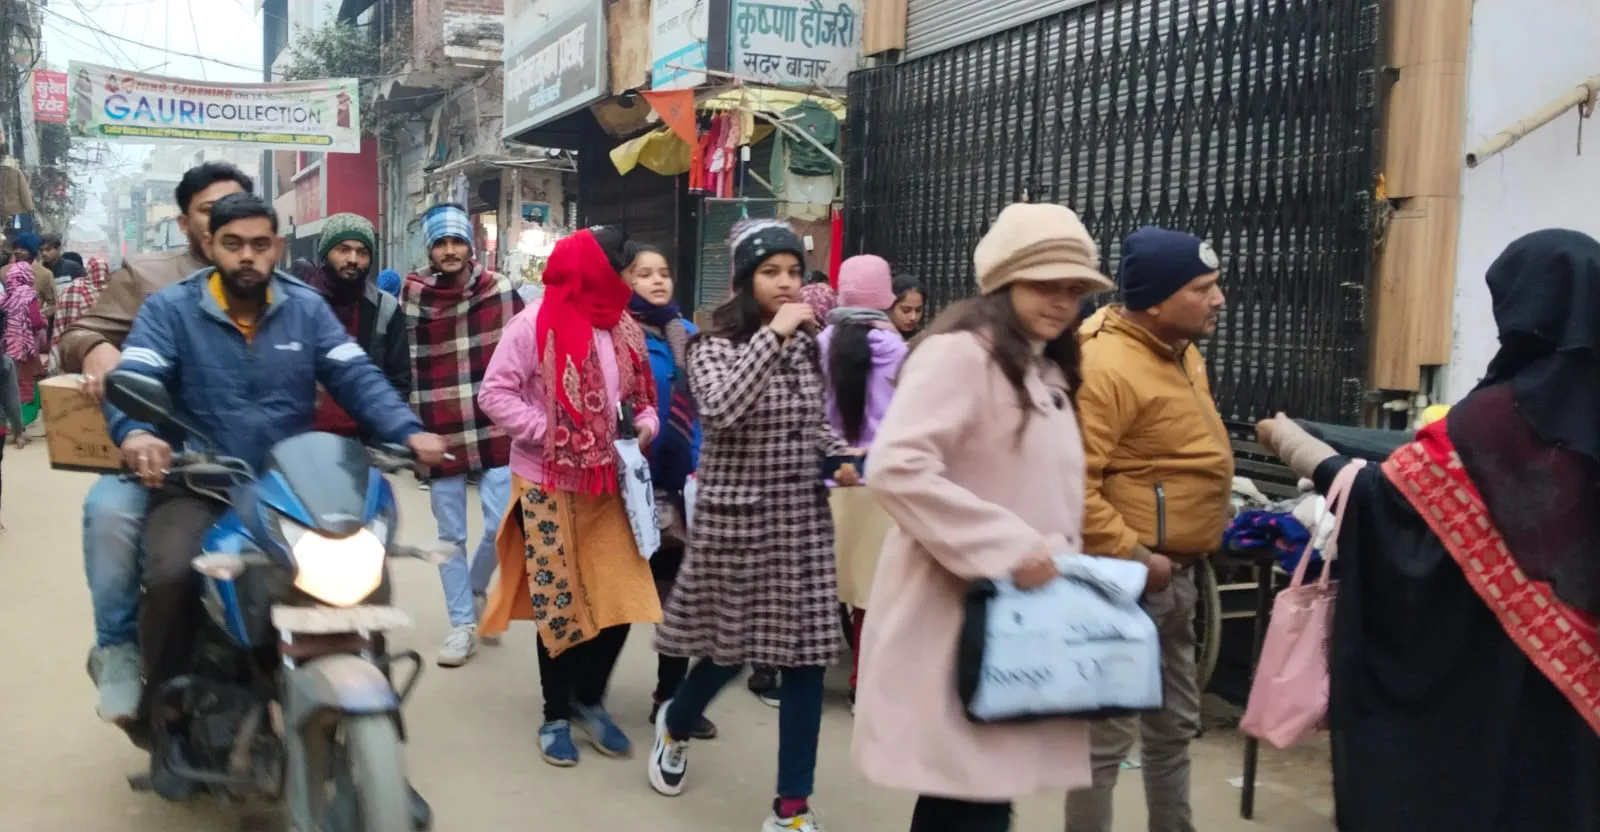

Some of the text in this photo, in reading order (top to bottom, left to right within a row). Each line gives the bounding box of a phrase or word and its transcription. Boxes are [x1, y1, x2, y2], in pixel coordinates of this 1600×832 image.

[737, 2, 798, 49] कृष्णा
[743, 52, 831, 79] सदर बाजार
[104, 94, 321, 124] GAURI COLLECTION
